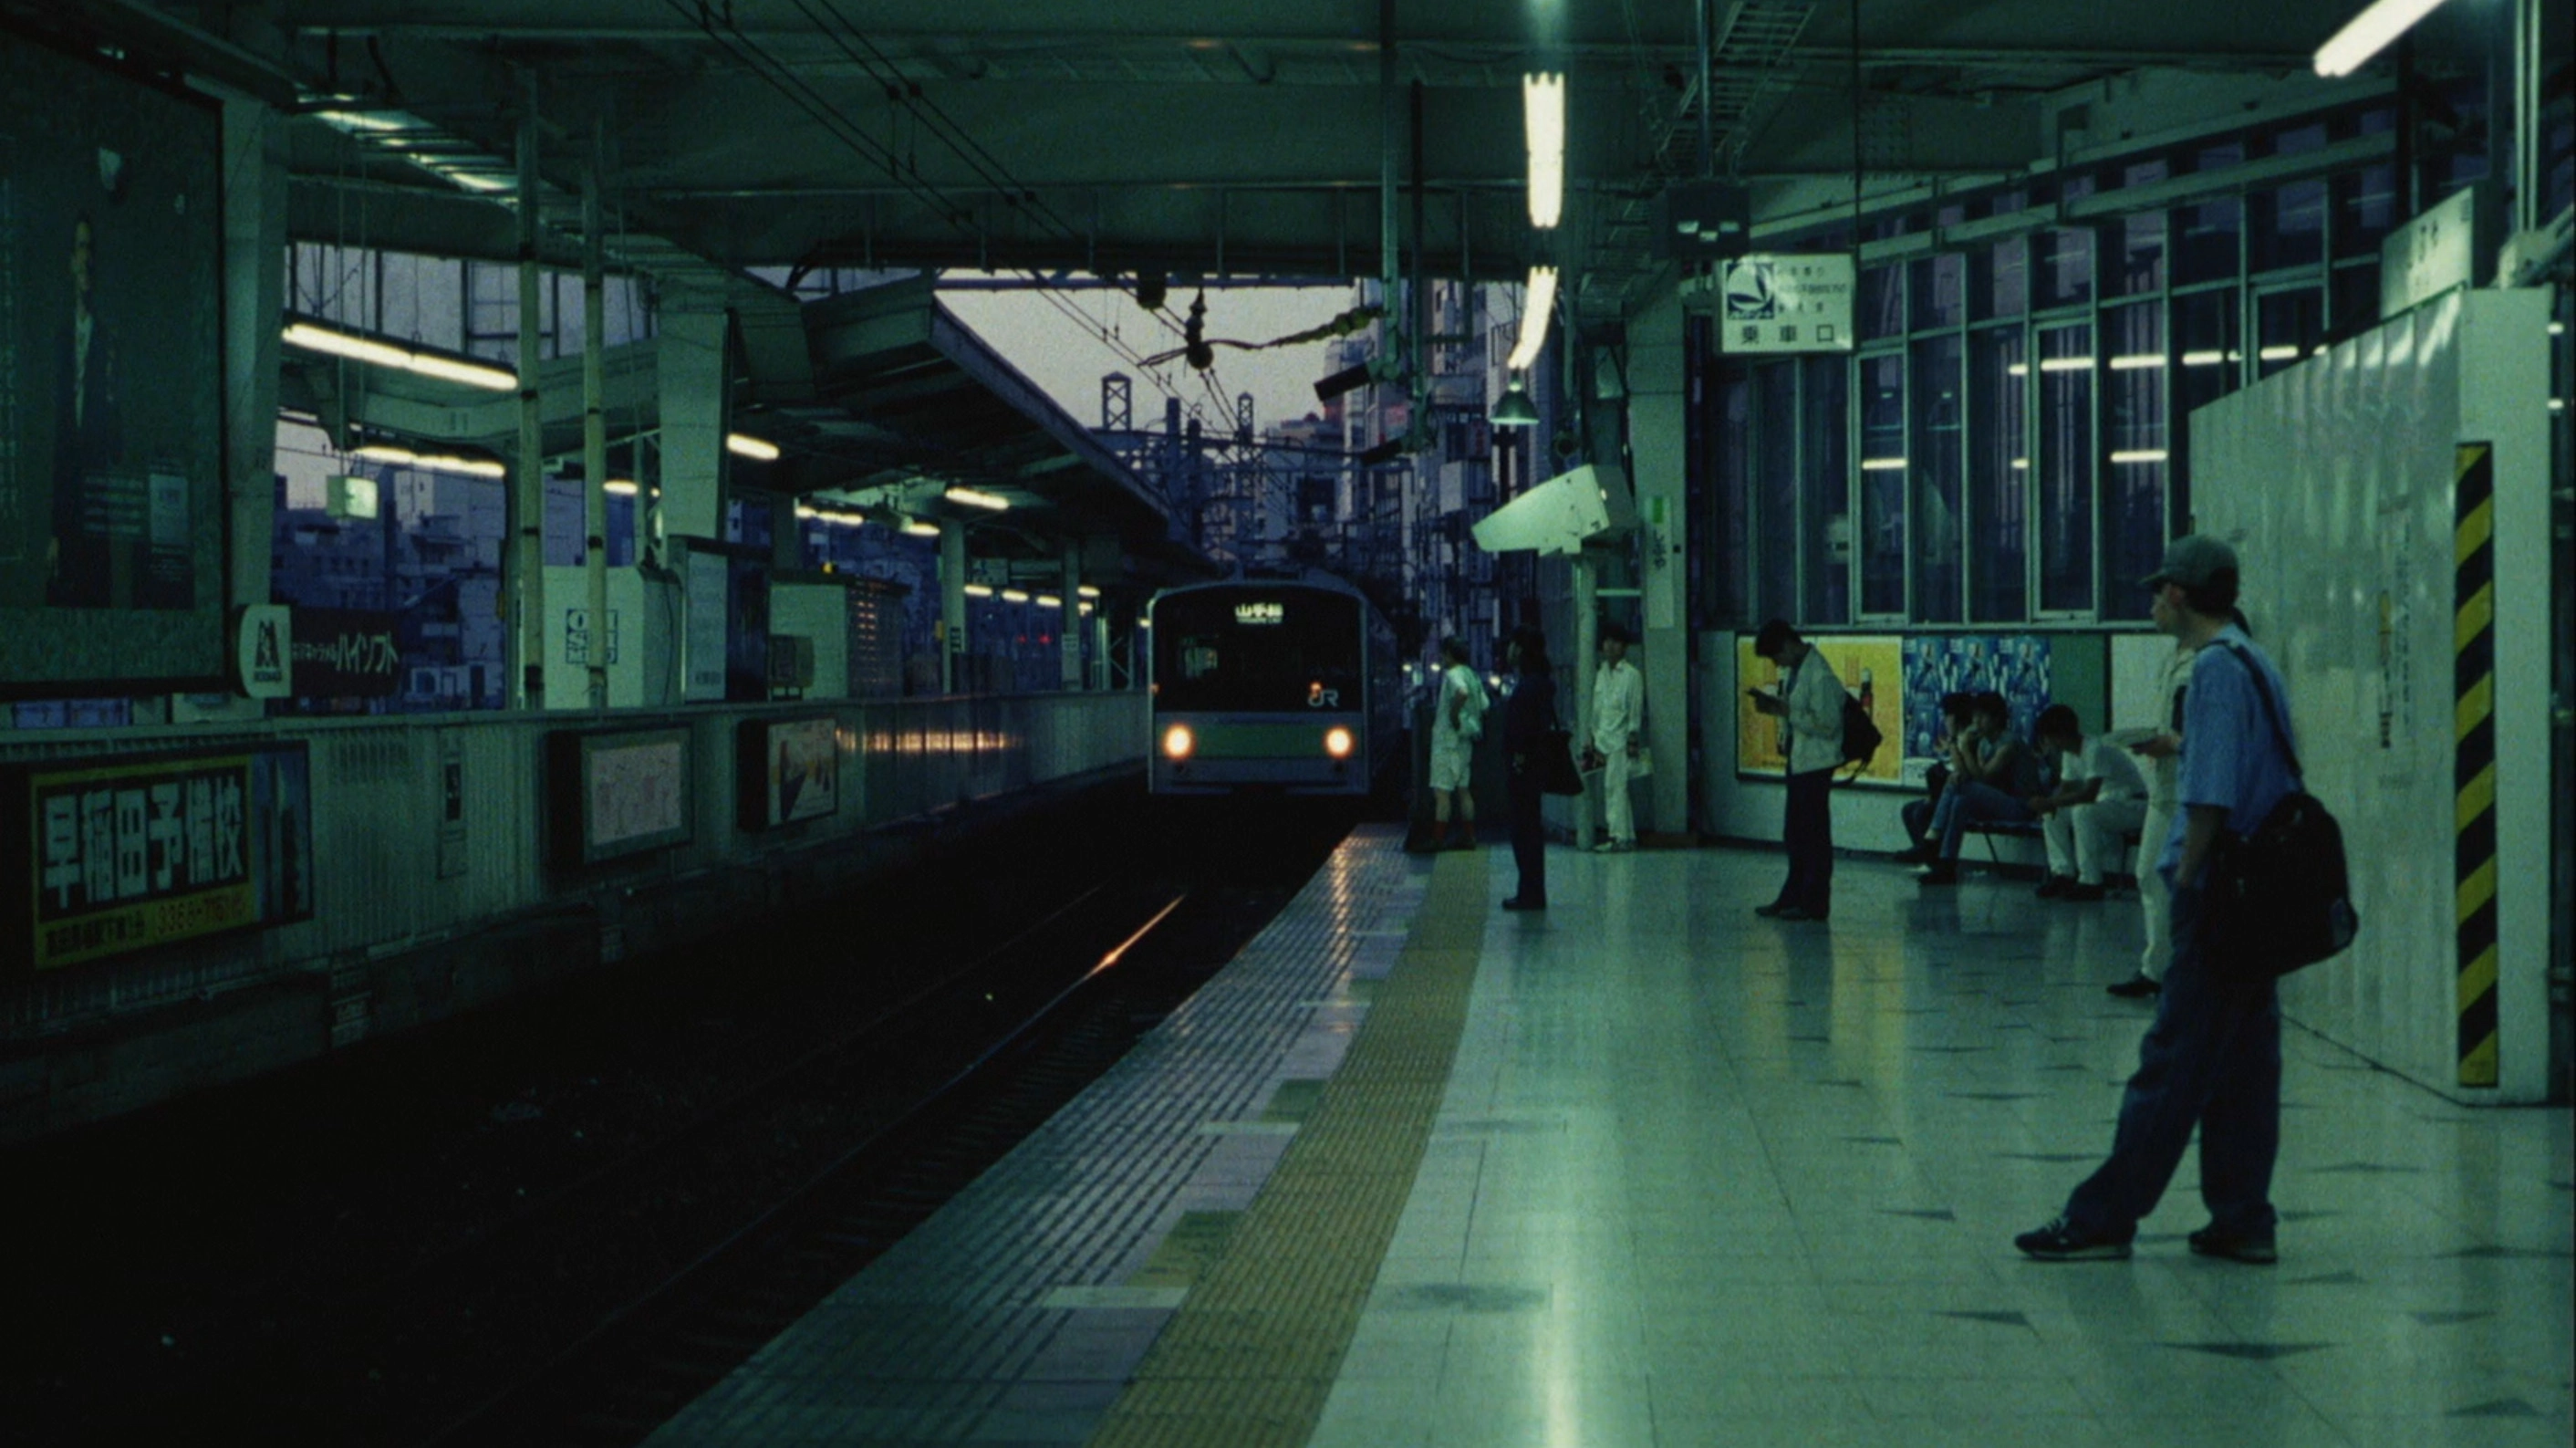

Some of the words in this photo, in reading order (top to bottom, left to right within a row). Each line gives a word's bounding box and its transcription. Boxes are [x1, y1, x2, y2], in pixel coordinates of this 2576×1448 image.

[335, 630, 399, 674] ハイソフト
[1308, 689, 1338, 707] JR
[45, 775, 243, 910] 早稲田予備校
